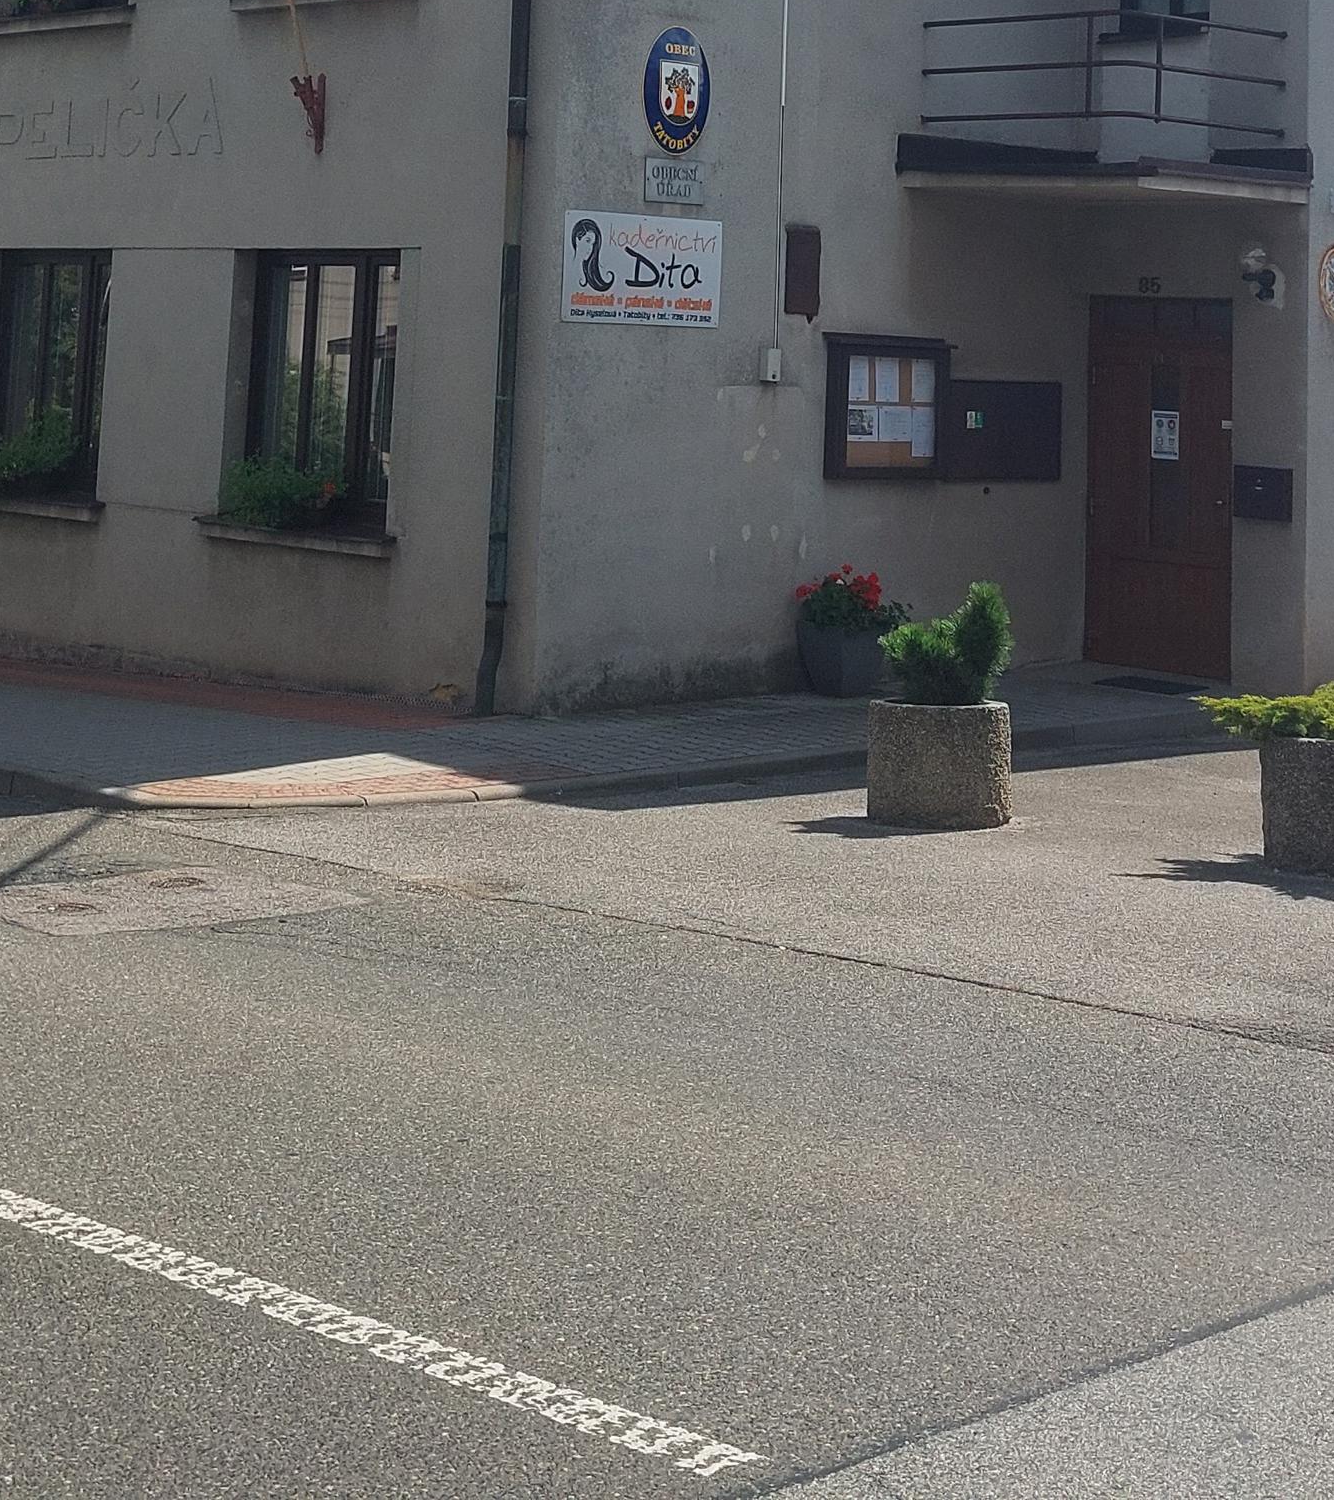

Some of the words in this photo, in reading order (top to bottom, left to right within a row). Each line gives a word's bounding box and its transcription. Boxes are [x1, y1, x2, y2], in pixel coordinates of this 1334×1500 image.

[665, 42, 696, 57] OBEC
[653, 121, 700, 150] TATOBITY
[652, 164, 699, 182] OBECNÍ
[656, 179, 691, 198] ÚŘAD
[609, 223, 717, 253] kadeřnictví
[624, 246, 703, 289] Dita
